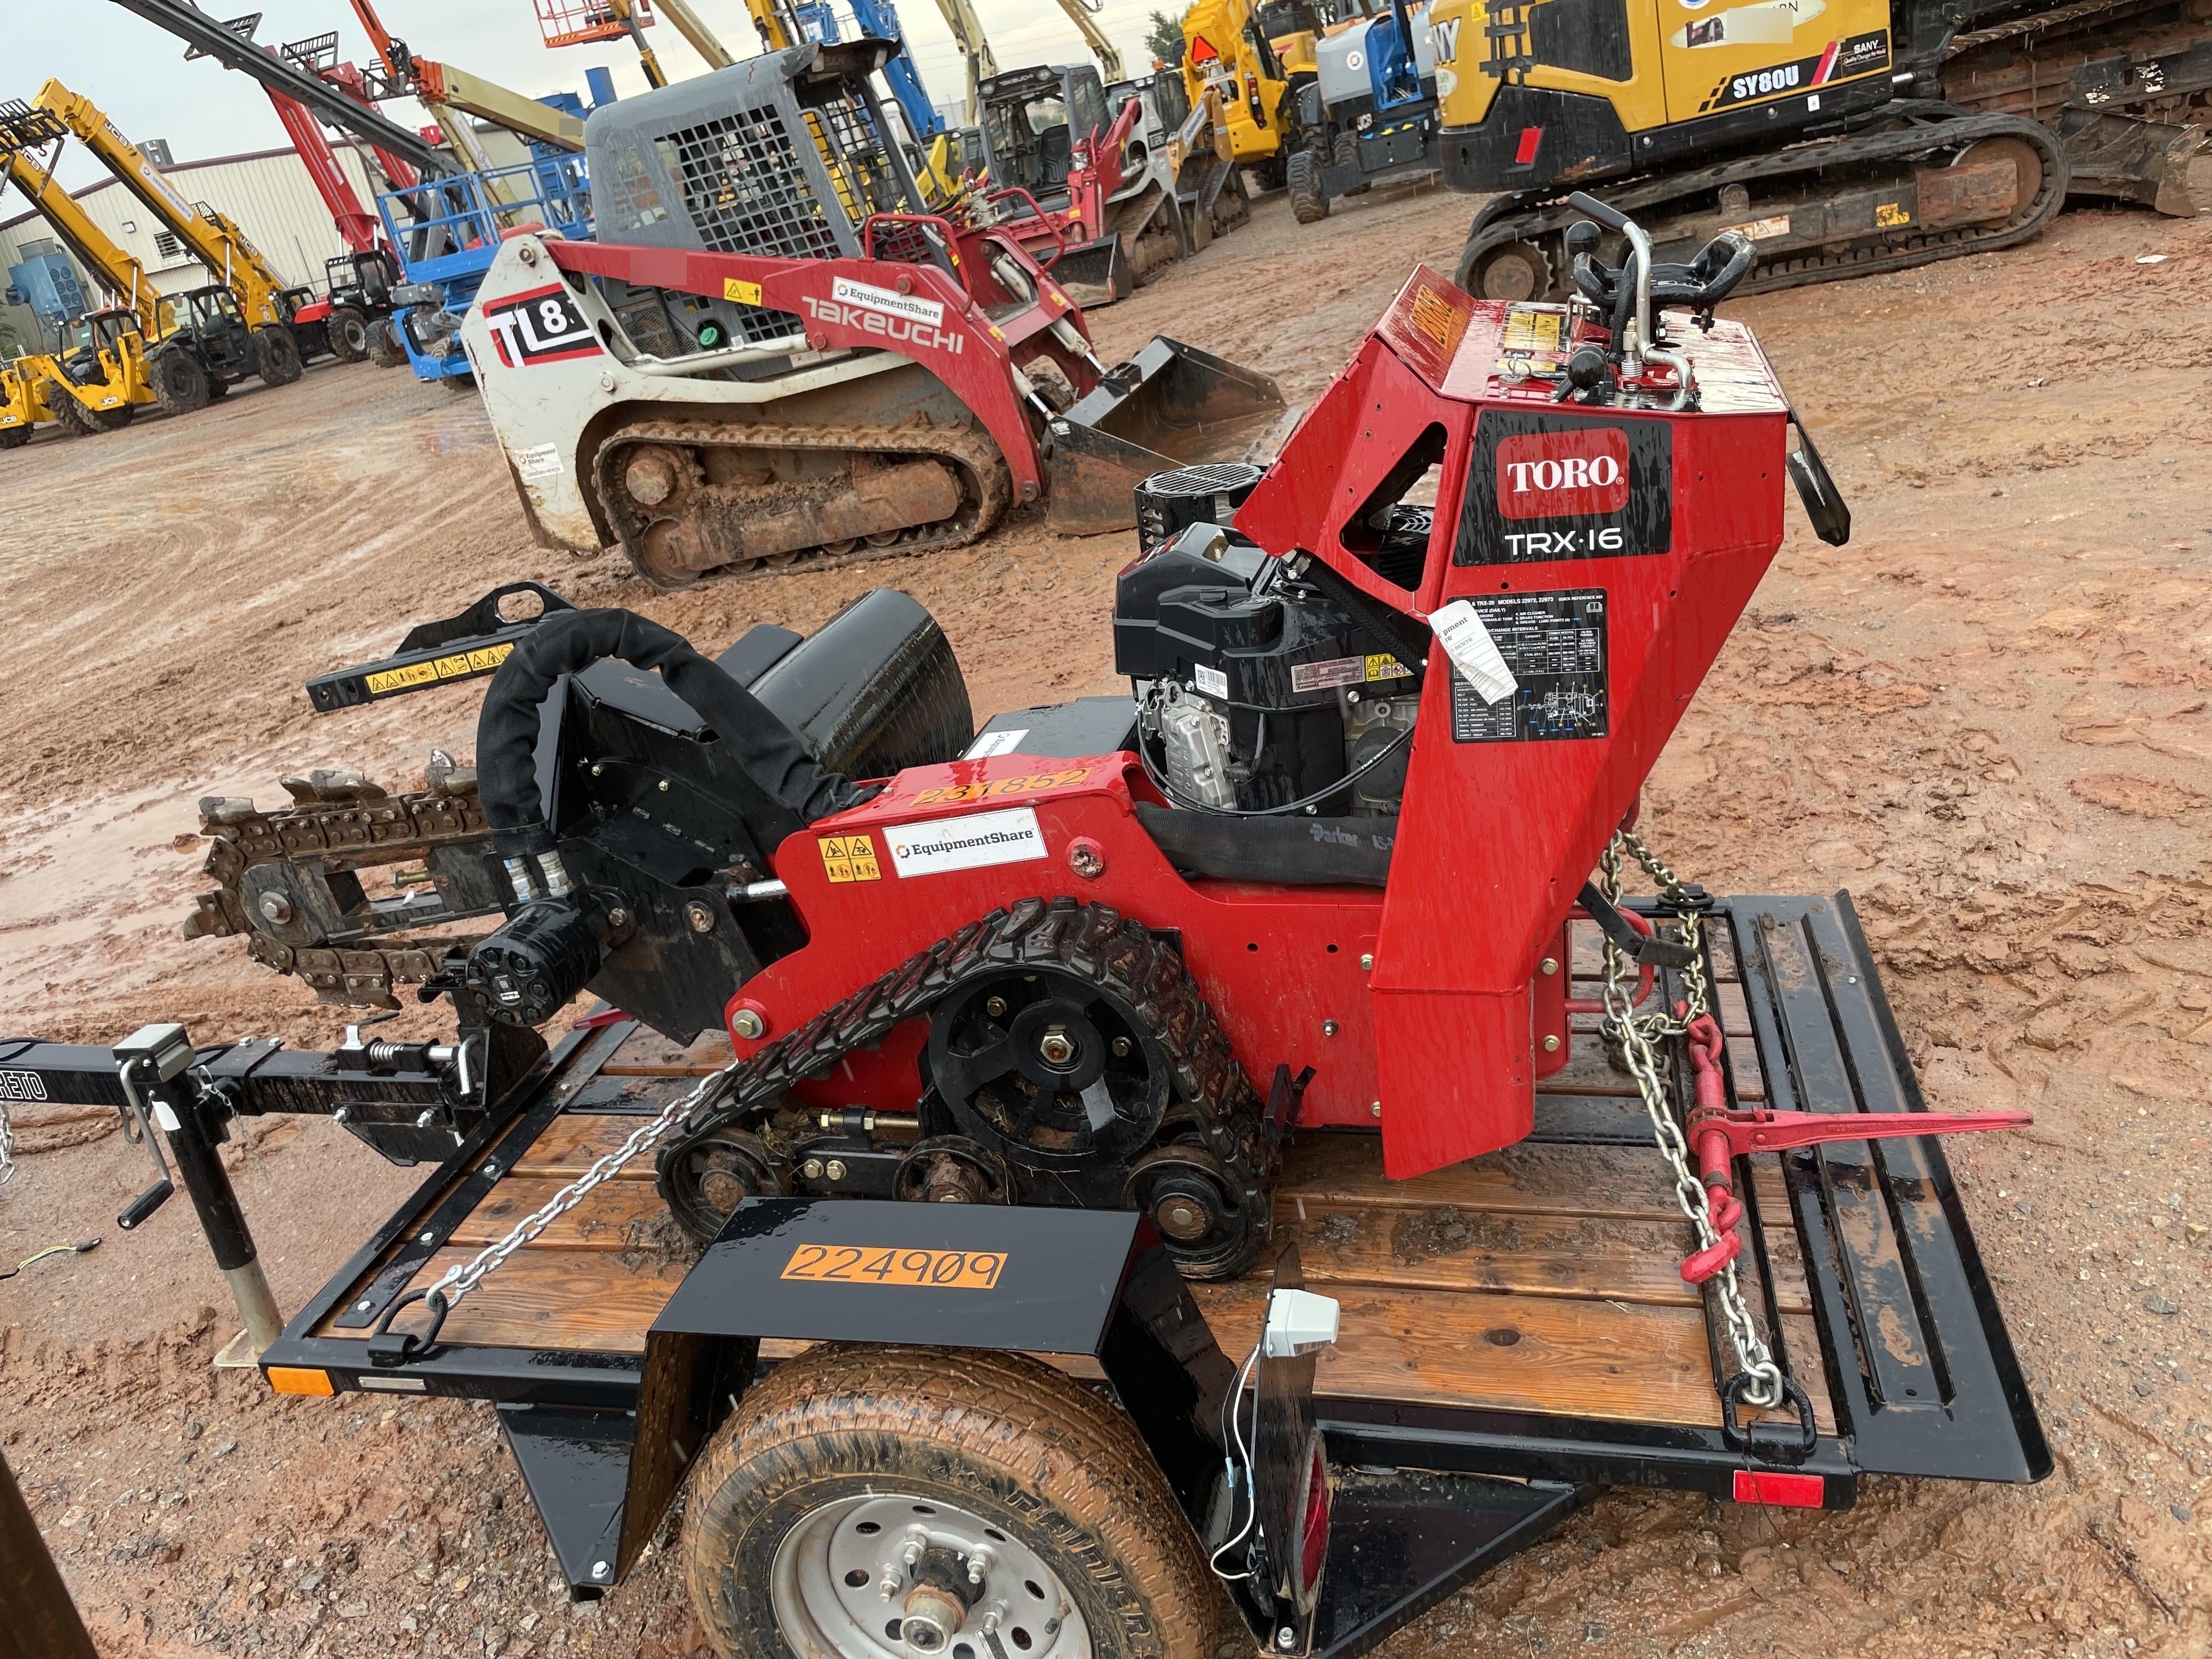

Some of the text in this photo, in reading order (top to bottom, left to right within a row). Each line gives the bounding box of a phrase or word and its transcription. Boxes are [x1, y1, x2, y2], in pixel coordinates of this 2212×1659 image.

[1854, 40, 1878, 54] SANY
[1733, 65, 1799, 99] SY80U
[103, 120, 129, 148] JCB
[239, 235, 259, 257] JCB
[850, 287, 939, 319] EquipmentShare
[1507, 455, 1619, 492] TORO
[1443, 616, 1469, 636] pment
[912, 768, 1087, 806] 231852
[911, 829, 1034, 856] EquipmentShare
[0, 1070, 48, 1100] RETO
[788, 1246, 1000, 1285] 224909
